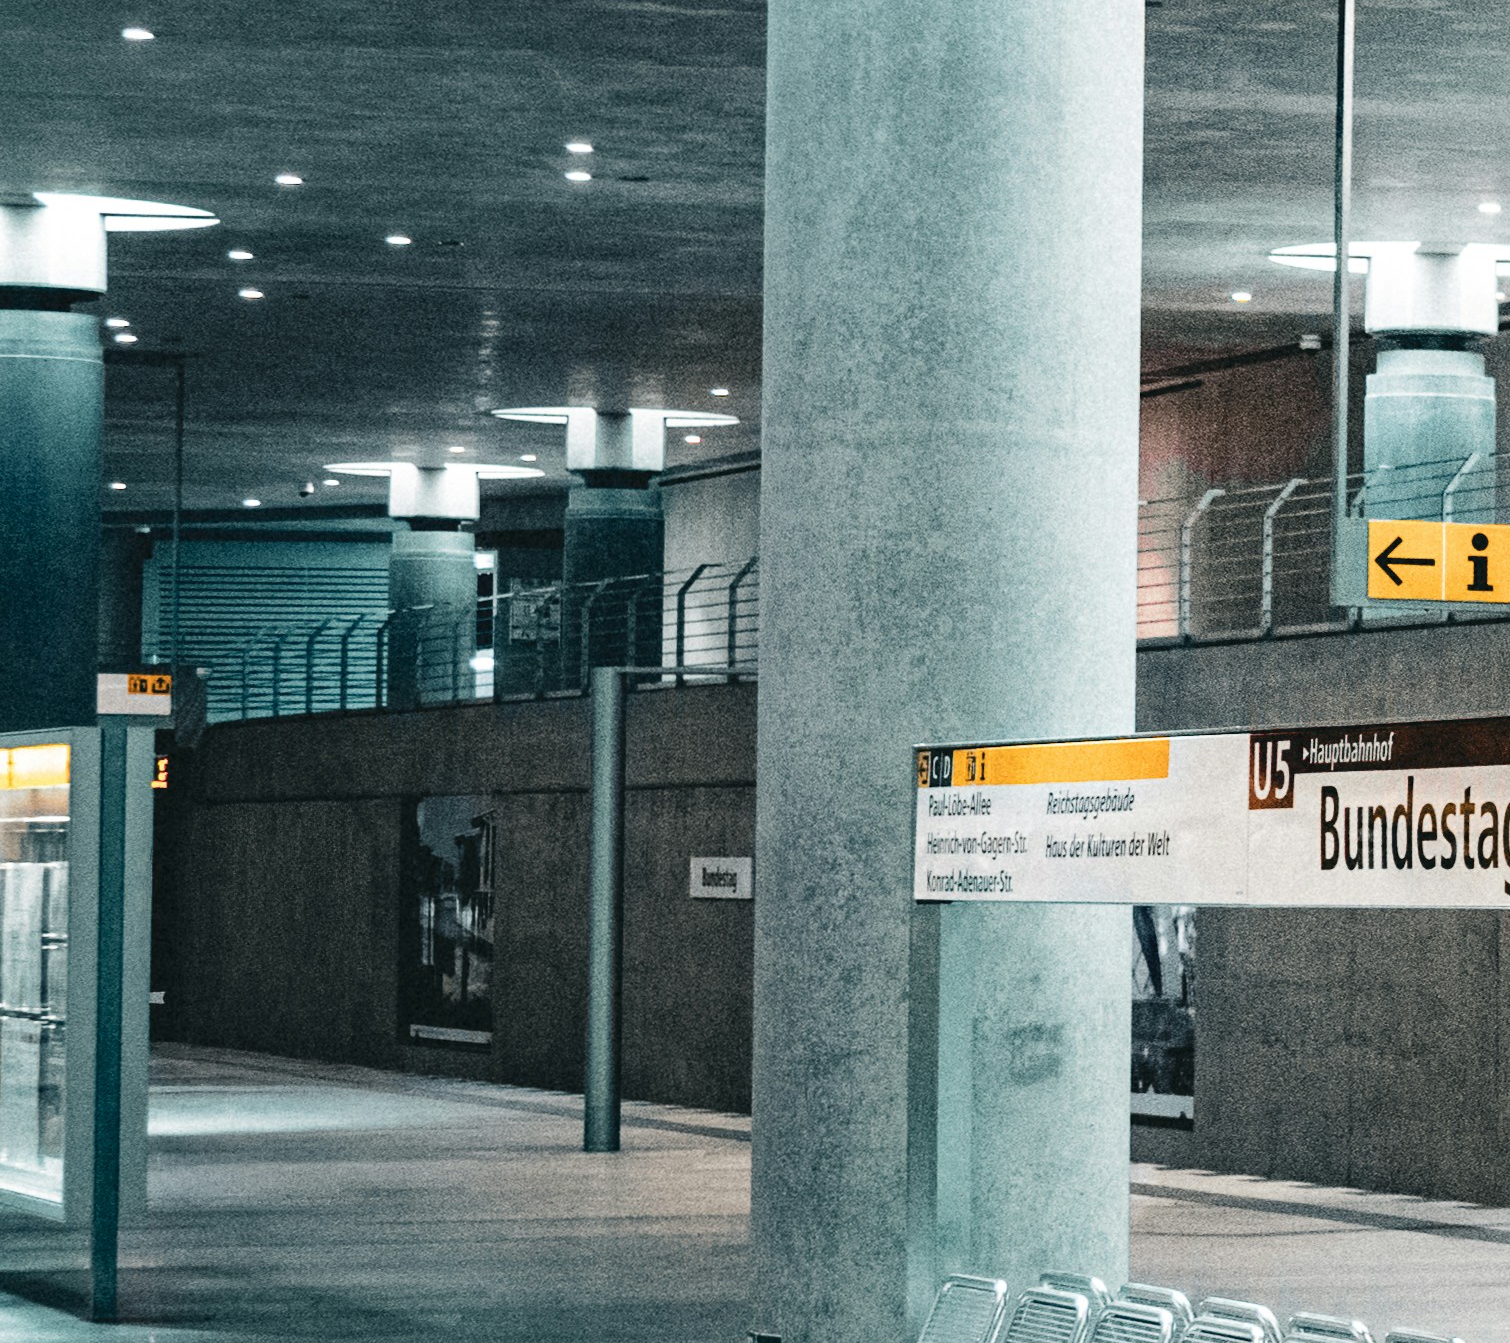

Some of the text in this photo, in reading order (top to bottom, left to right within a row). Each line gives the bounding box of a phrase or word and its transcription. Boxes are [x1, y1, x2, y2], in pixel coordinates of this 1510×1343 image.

[932, 755, 940, 779] C
[942, 754, 951, 779] D
[1252, 731, 1395, 801] U5 Hauptbahnhof
[1046, 787, 1136, 820] Reichstagsgebäude
[1045, 829, 1171, 858] Haus der Kulturen der Welt
